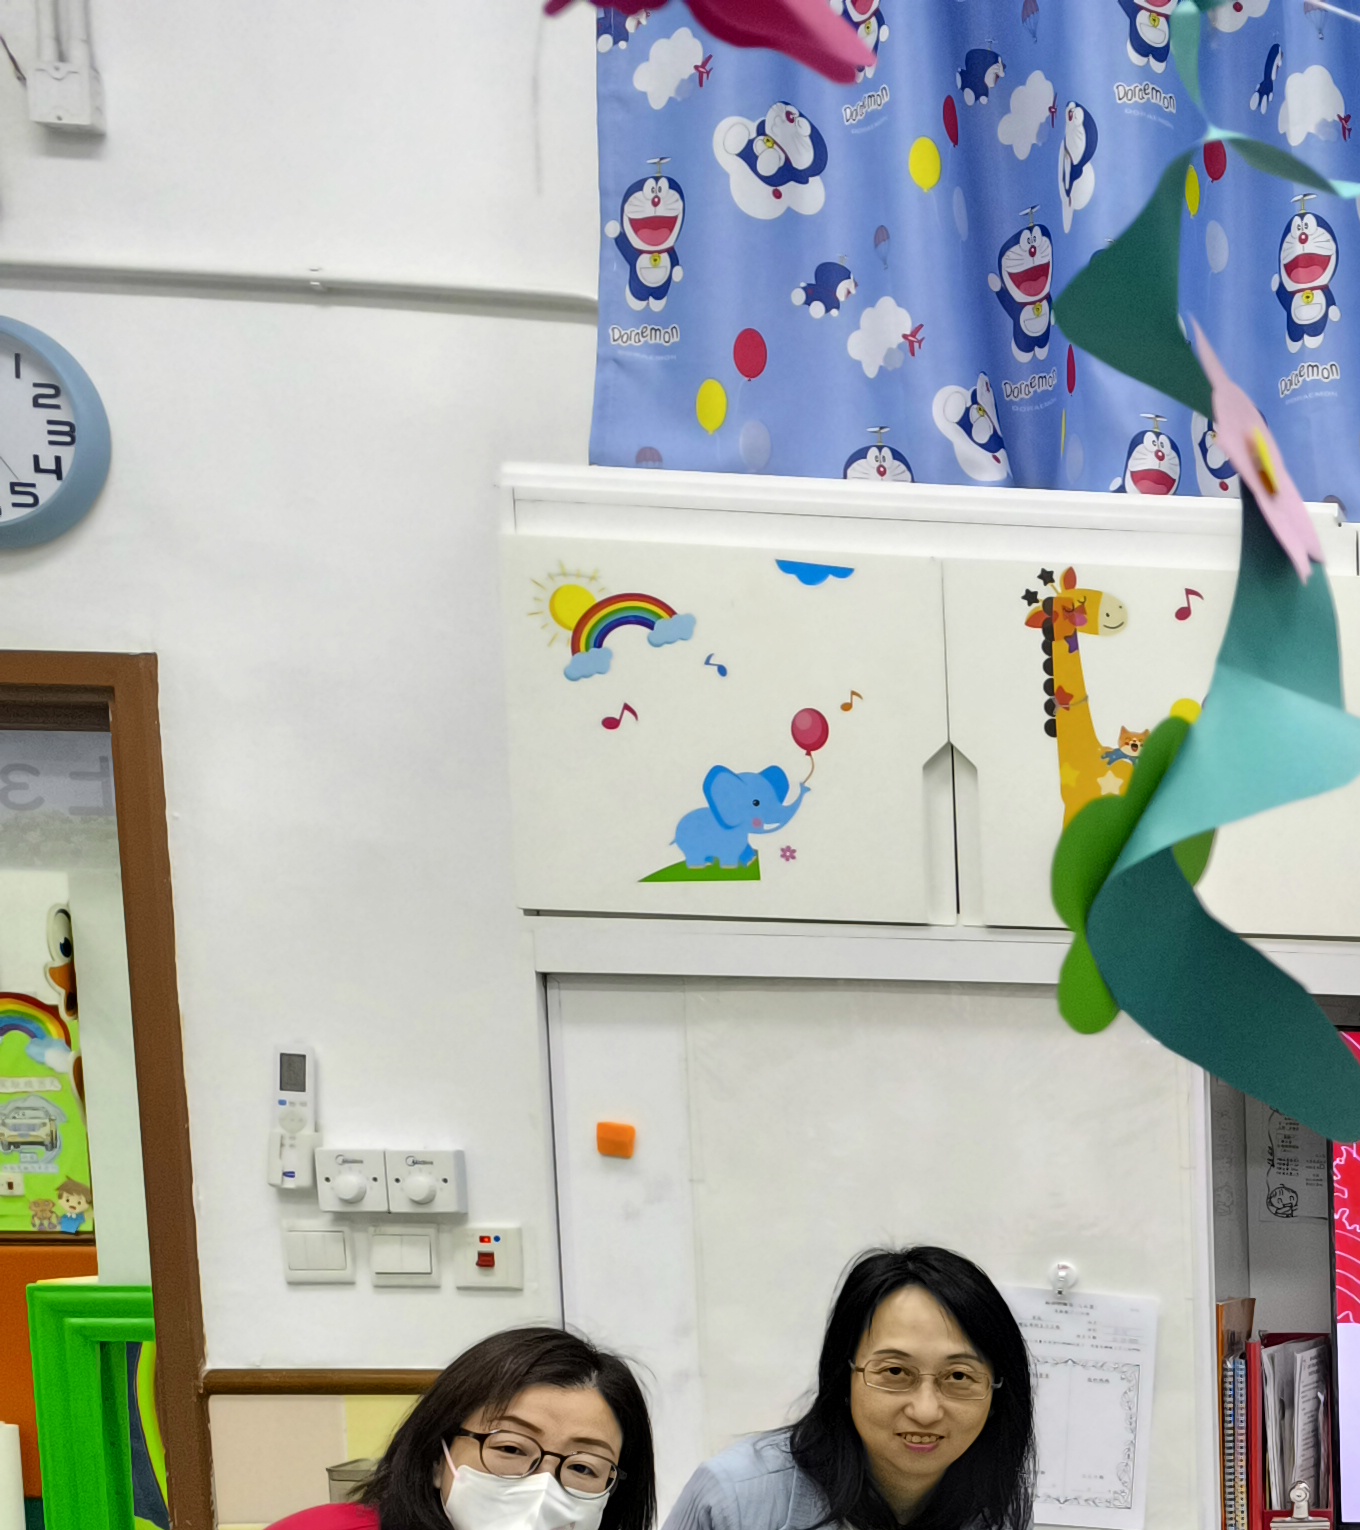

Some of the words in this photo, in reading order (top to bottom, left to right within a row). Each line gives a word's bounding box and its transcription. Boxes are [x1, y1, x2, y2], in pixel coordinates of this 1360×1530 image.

[608, 324, 680, 345] Doraemon
[14, 353, 21, 379] 1
[32, 382, 62, 410] 2
[46, 419, 76, 446] 3
[33, 454, 63, 481] 4
[9, 481, 40, 508] 5
